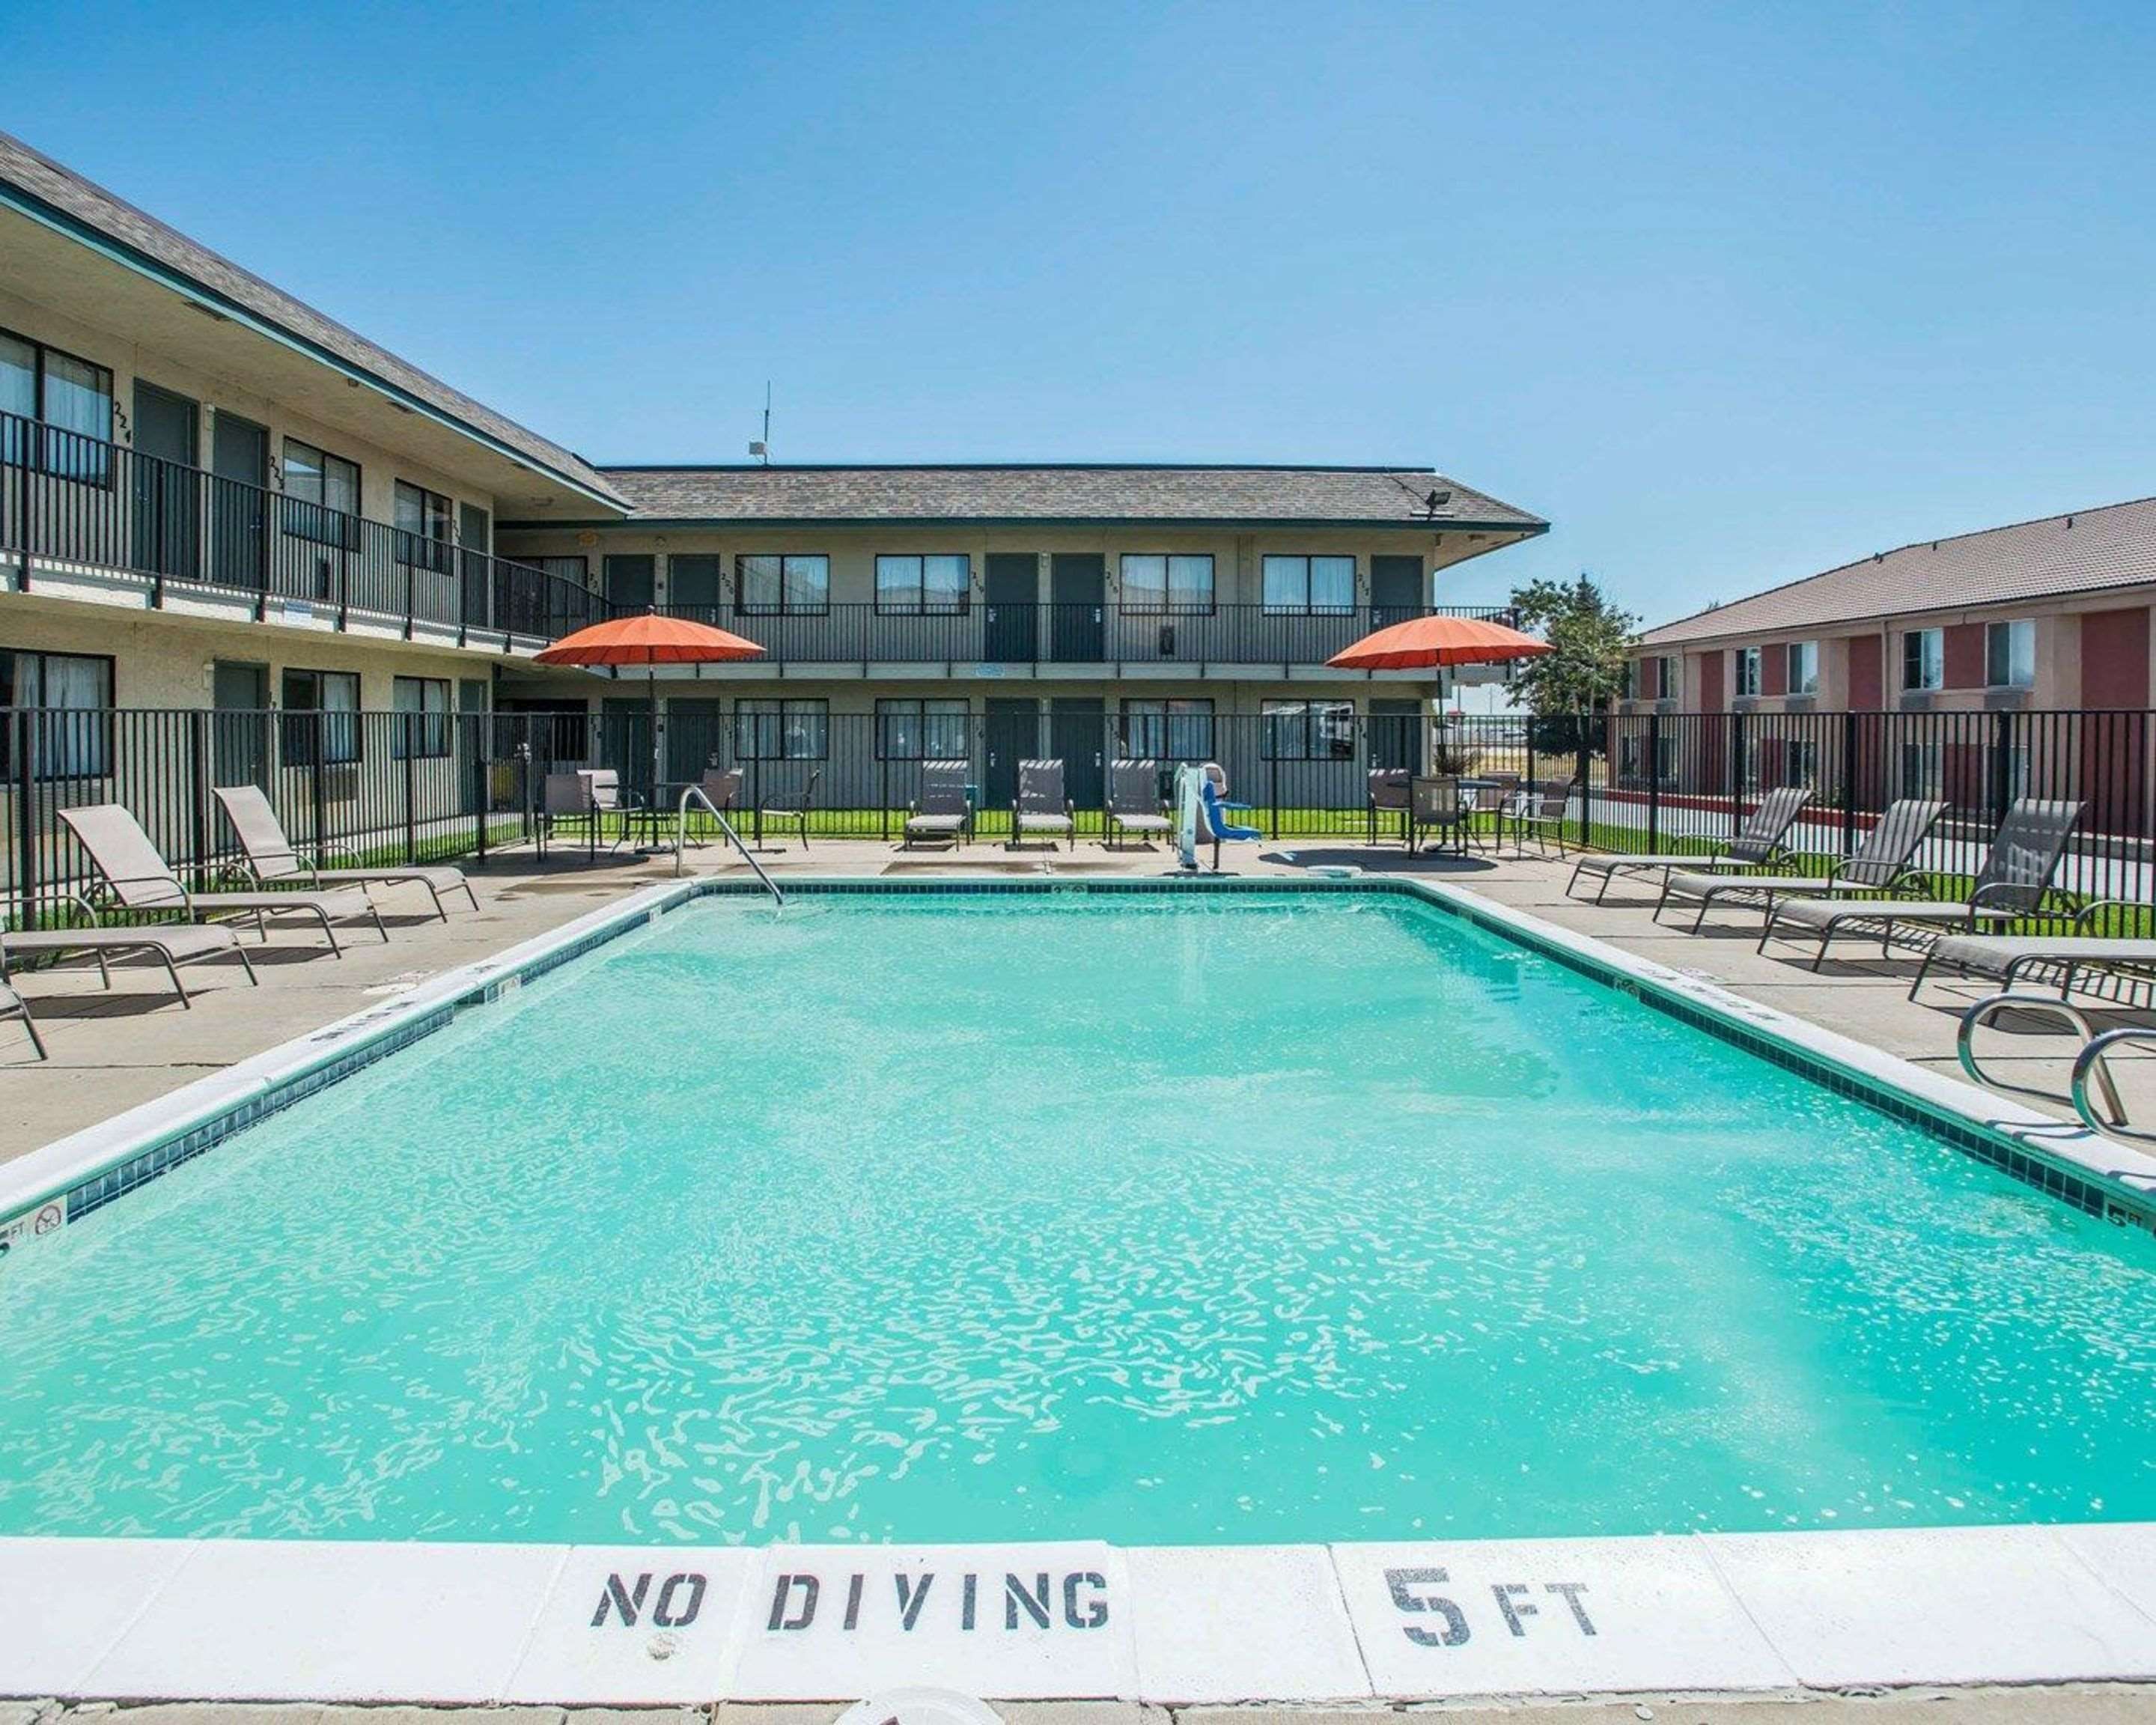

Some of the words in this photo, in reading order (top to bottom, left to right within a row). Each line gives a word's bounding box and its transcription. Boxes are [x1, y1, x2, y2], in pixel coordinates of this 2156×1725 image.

[114, 401, 132, 444] 224
[590, 1573, 707, 1627] NO
[767, 1572, 1109, 1631] DIVING
[1383, 1567, 1471, 1646] 5
[1490, 1582, 1598, 1637] FT
